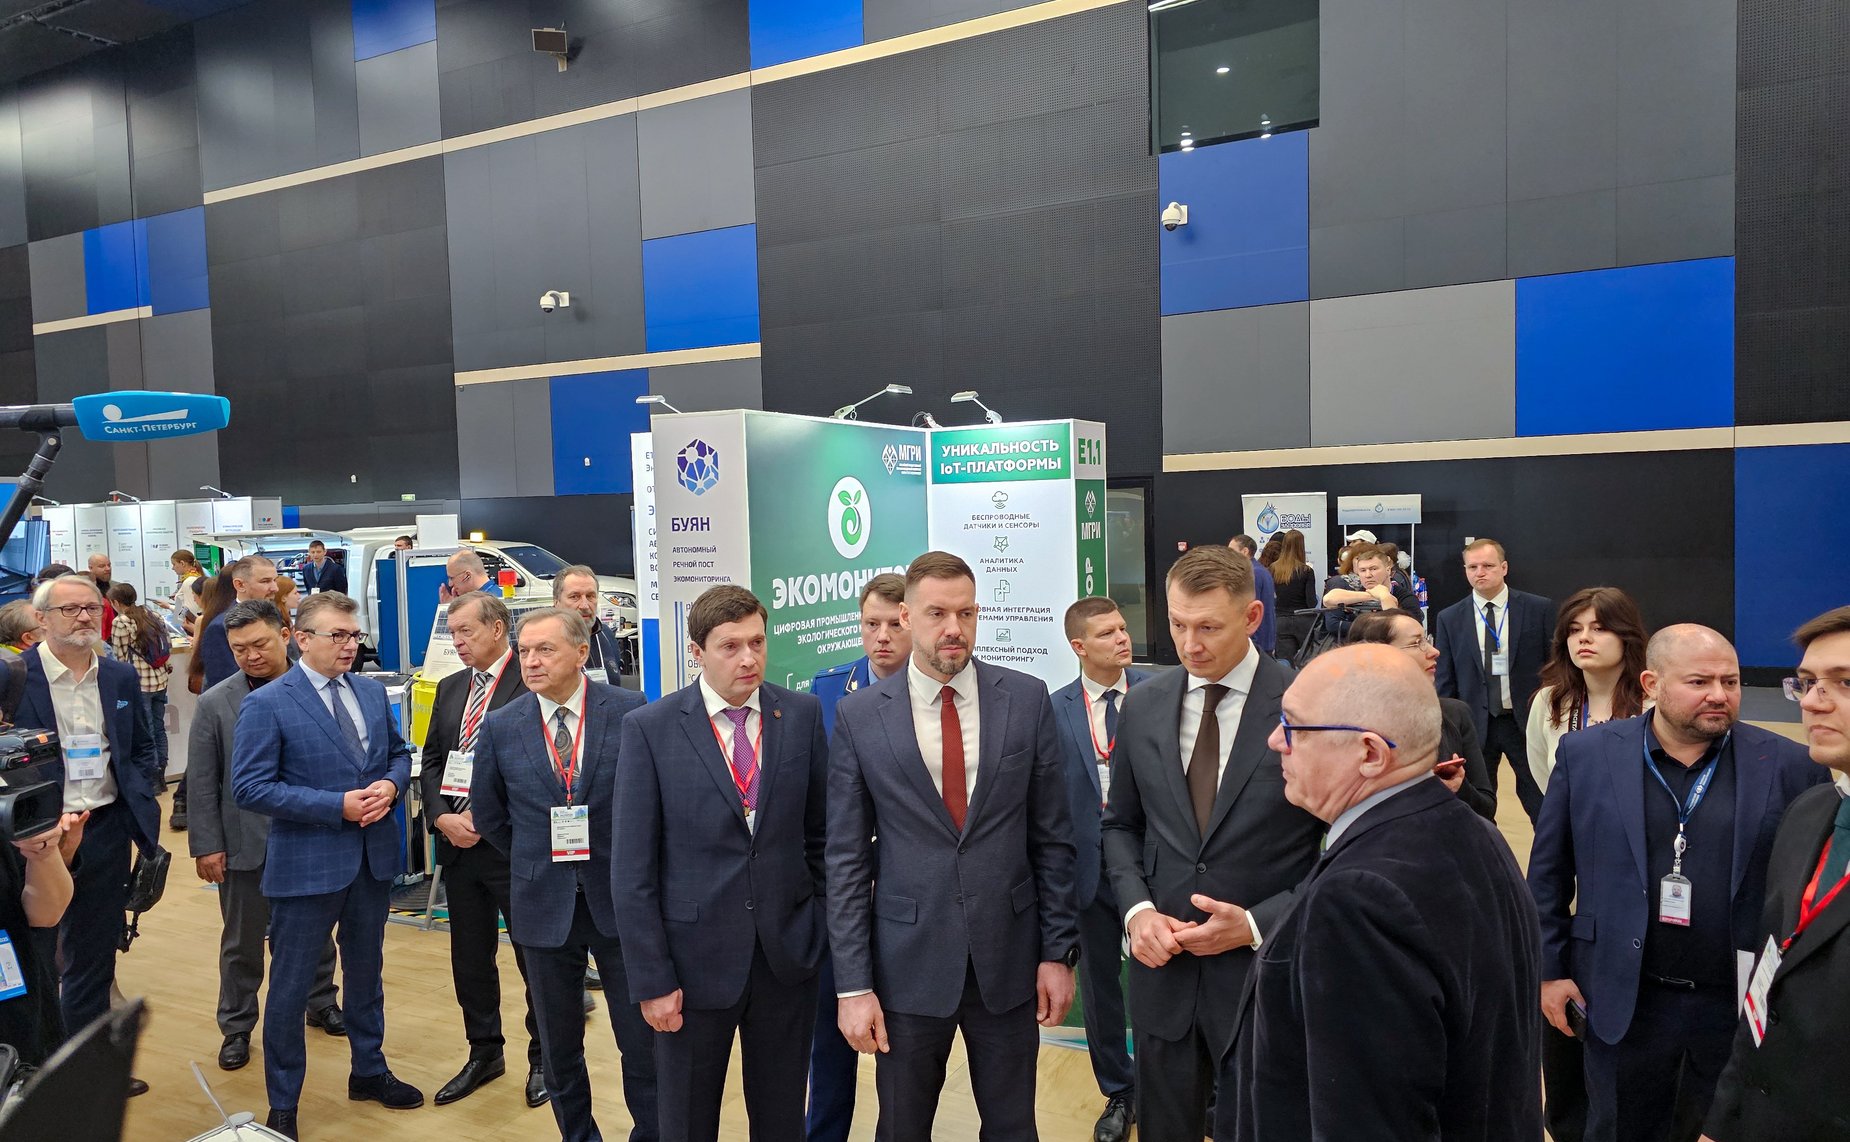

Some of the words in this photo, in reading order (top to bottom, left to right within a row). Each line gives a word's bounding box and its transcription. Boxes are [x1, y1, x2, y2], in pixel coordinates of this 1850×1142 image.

[104, 422, 198, 434] САНКТ-ПЕТЕРБУРГ
[898, 444, 922, 461] МГРИ
[941, 439, 1060, 458] УНИКАЛЬНОСТЬ
[940, 457, 1062, 475] IoT-ПЛАТФОРМЫ
[971, 513, 1031, 521] БЕСПРОВОДНЫЕ
[671, 517, 711, 532] БУЯН
[963, 523, 996, 531] ДАТЧИКИ
[998, 522, 1003, 530] И
[1004, 521, 1040, 529] СЕНСОРЫ
[1081, 521, 1101, 541] МГРИ
[672, 545, 718, 554] АВТОНОМНЫЙ
[673, 560, 697, 568] РЕЧНОЙ
[979, 557, 1024, 565] АНАЛИТИКА
[985, 566, 1018, 574] ДАННЫХ
[673, 575, 732, 583] ЭКОМОНИТОРИНГА
[1003, 607, 1051, 615] ИНТЕГРАЦИЯ
[1005, 615, 1054, 623] УПРАВЛЕНИЯ
[774, 619, 816, 636] ЦИФРОВАЯ
[797, 627, 858, 645] ЭКОЛОГИЧЕСКОГО
[1016, 647, 1049, 655] ПОДХОД
[980, 655, 1035, 663] МОНИТОРИНГУ
[796, 681, 810, 692] ДЛЯ
